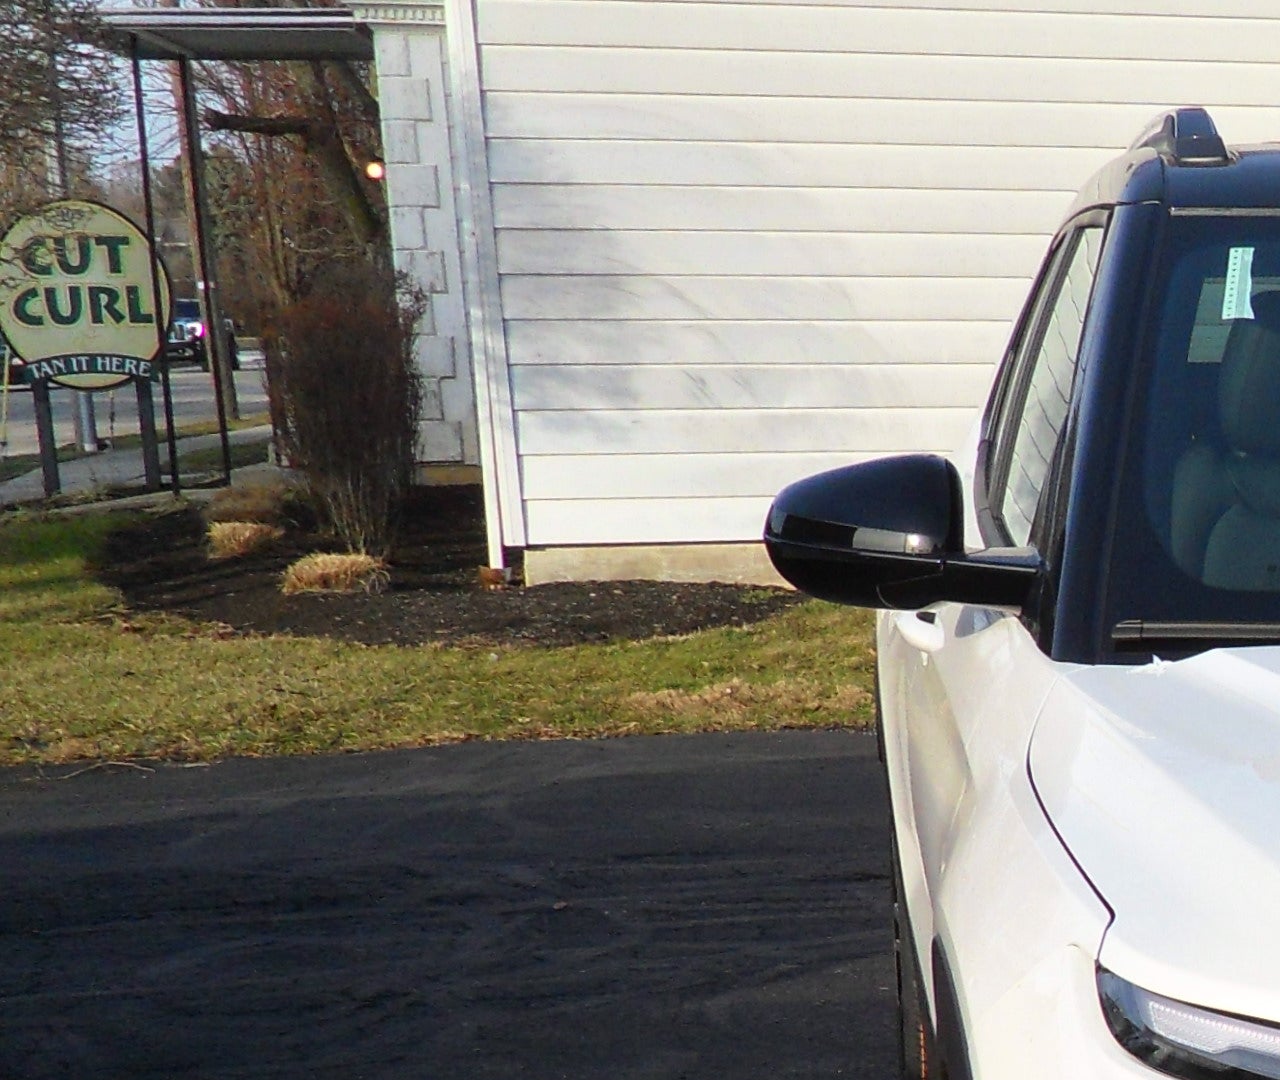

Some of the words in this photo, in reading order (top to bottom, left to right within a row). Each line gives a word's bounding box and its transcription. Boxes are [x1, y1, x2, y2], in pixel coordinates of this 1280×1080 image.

[20, 236, 130, 275] CUT
[12, 285, 154, 326] CURL
[26, 359, 67, 379] TAN
[69, 356, 90, 372] IT
[97, 356, 152, 377] HERE
